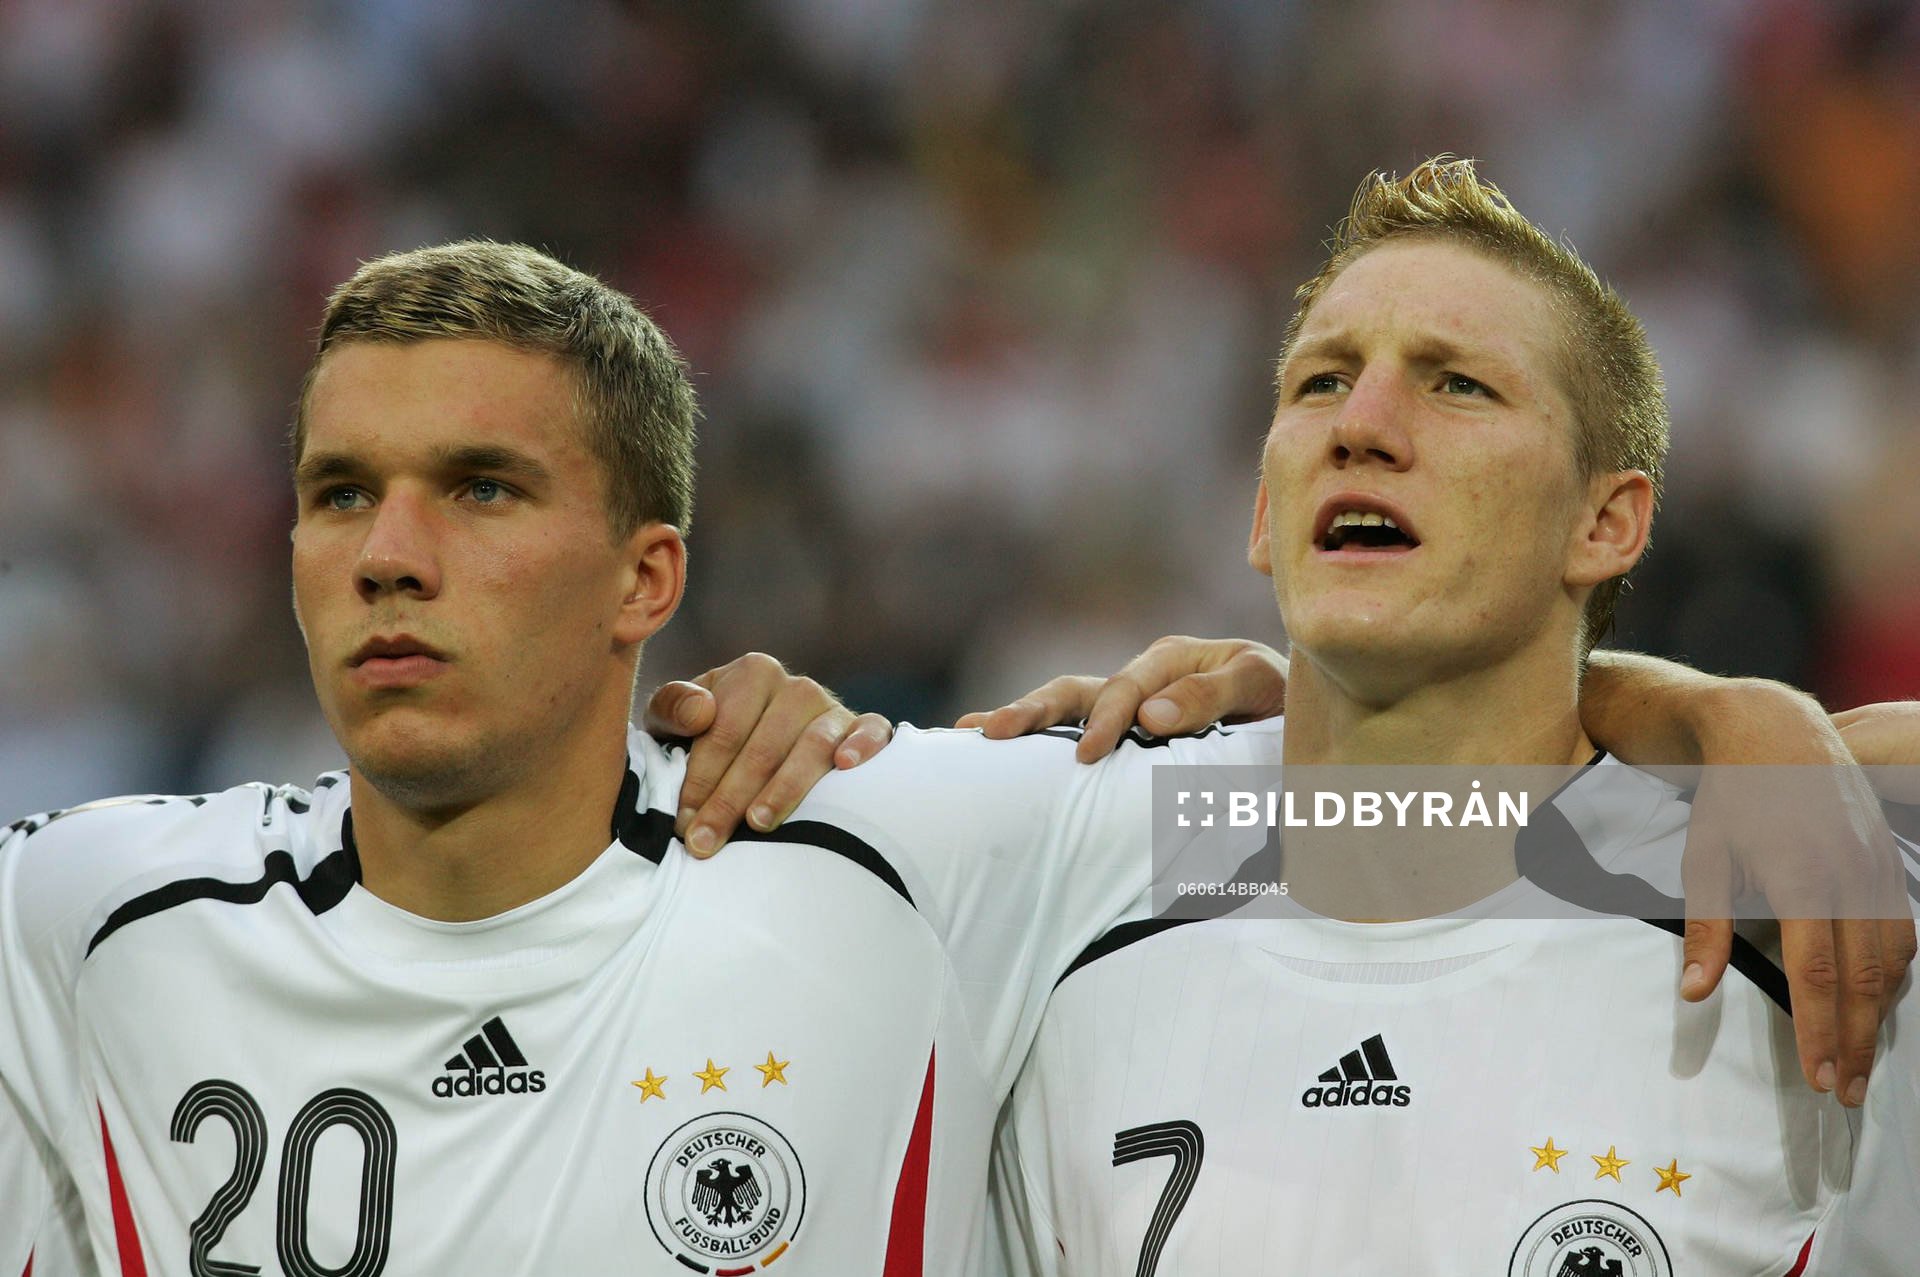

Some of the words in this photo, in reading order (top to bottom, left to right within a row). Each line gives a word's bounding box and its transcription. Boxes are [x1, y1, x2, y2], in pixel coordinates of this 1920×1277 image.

[432, 1066, 546, 1098] adidas
[1302, 1080, 1411, 1107] adidas
[676, 1132, 766, 1168] DEUTSCHER
[170, 1078, 397, 1277] 20
[1112, 1119, 1204, 1277] 7
[675, 1206, 781, 1254] FUSSBALL-BUND
[1551, 1220, 1642, 1258] DEUTSCHER
